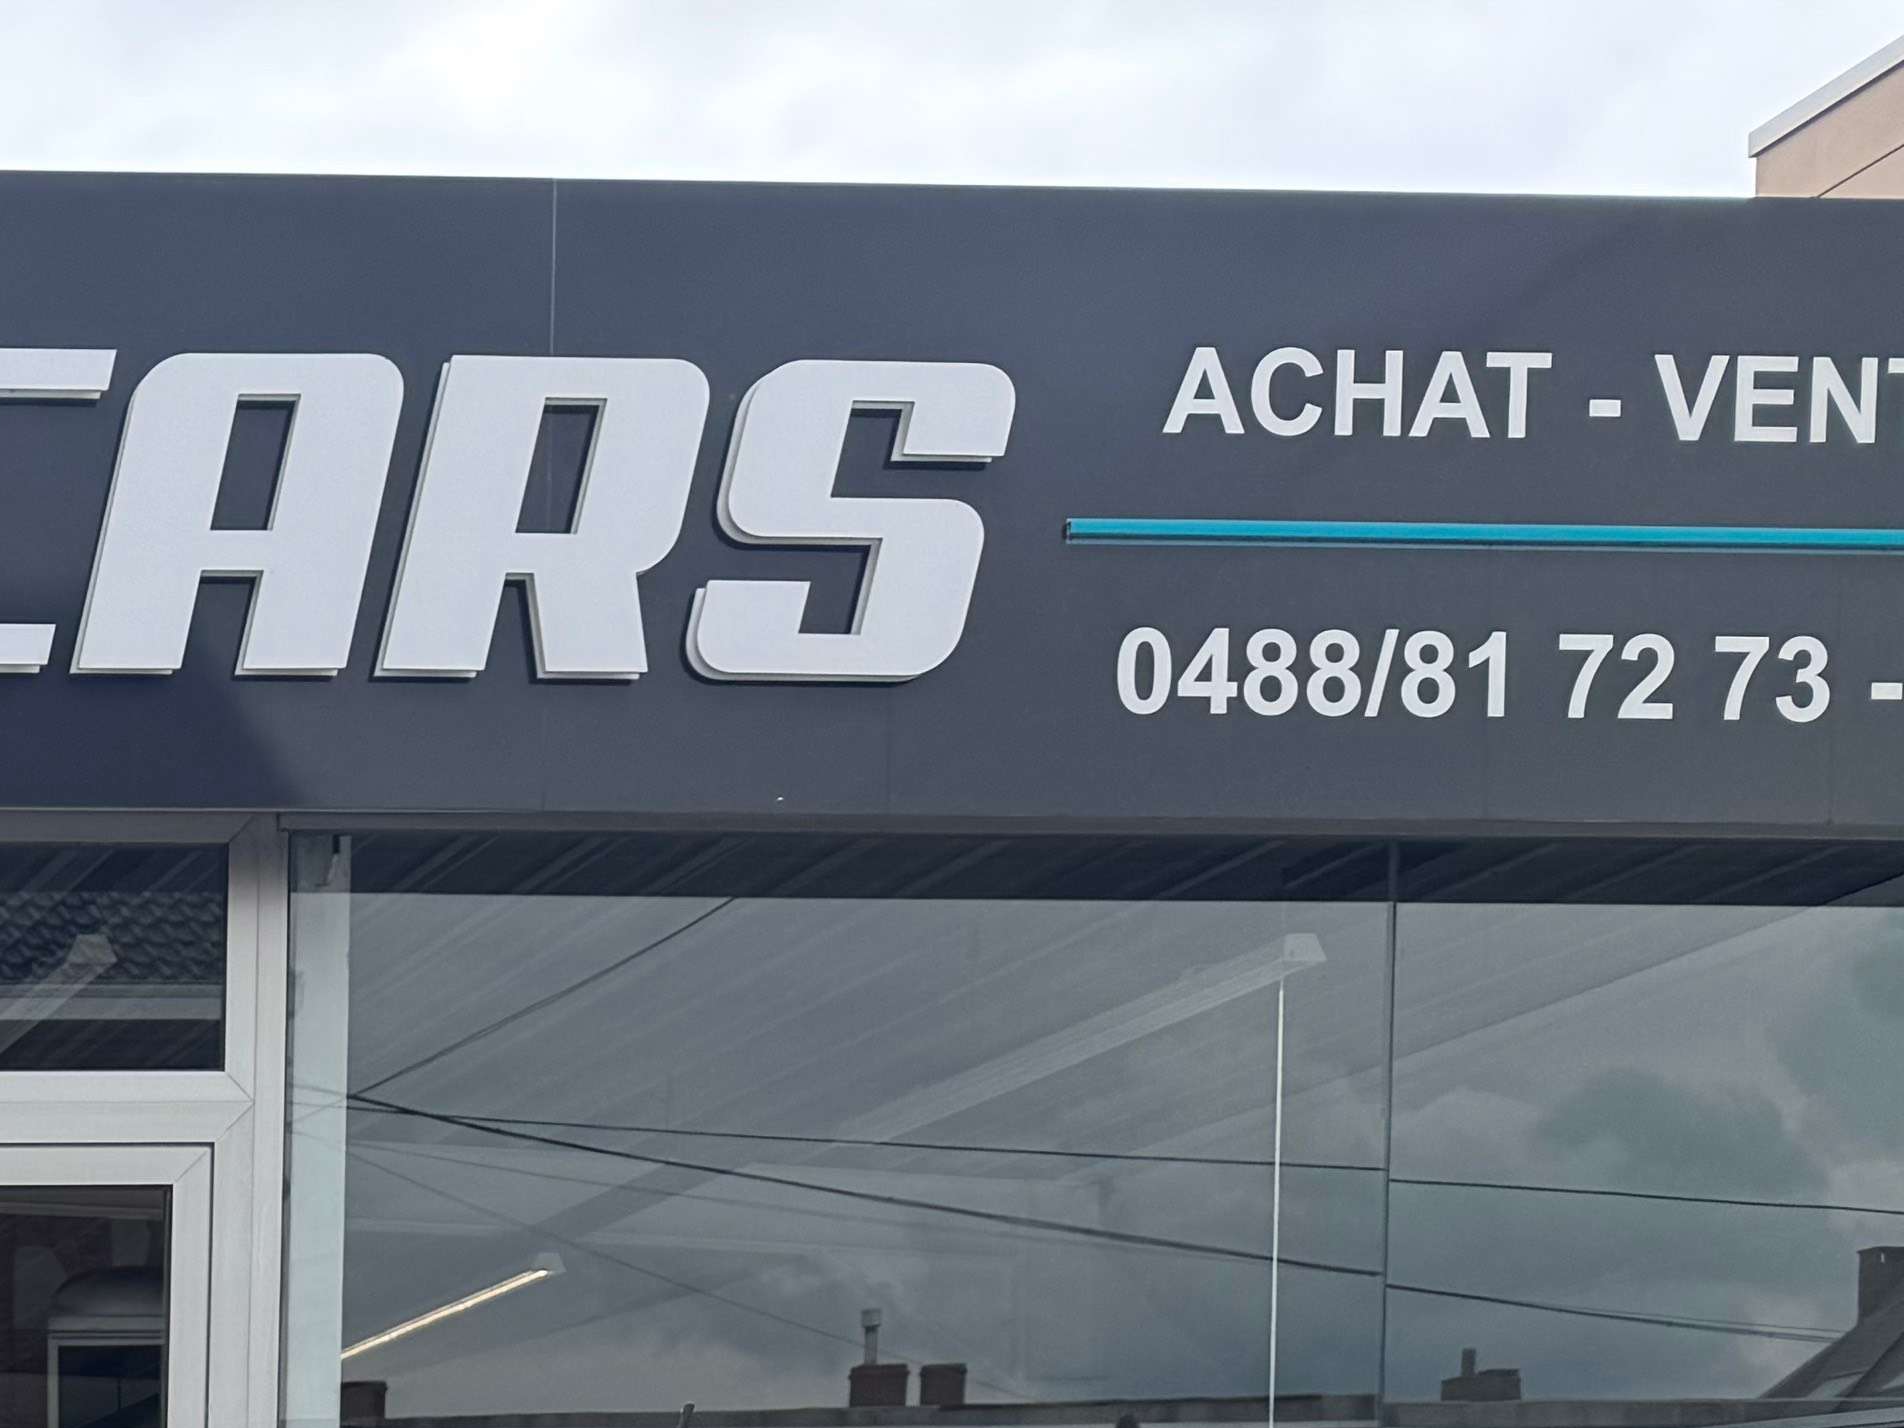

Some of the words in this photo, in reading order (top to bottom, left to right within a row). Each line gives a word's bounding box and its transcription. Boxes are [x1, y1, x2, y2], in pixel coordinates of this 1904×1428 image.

[1163, 347, 1553, 439] ACHAT
[1588, 398, 1622, 418] -
[1654, 354, 1904, 444] VEN
[1116, 627, 1508, 718] 0488/81
[1558, 634, 1675, 720] 72
[1713, 636, 1830, 723] 73
